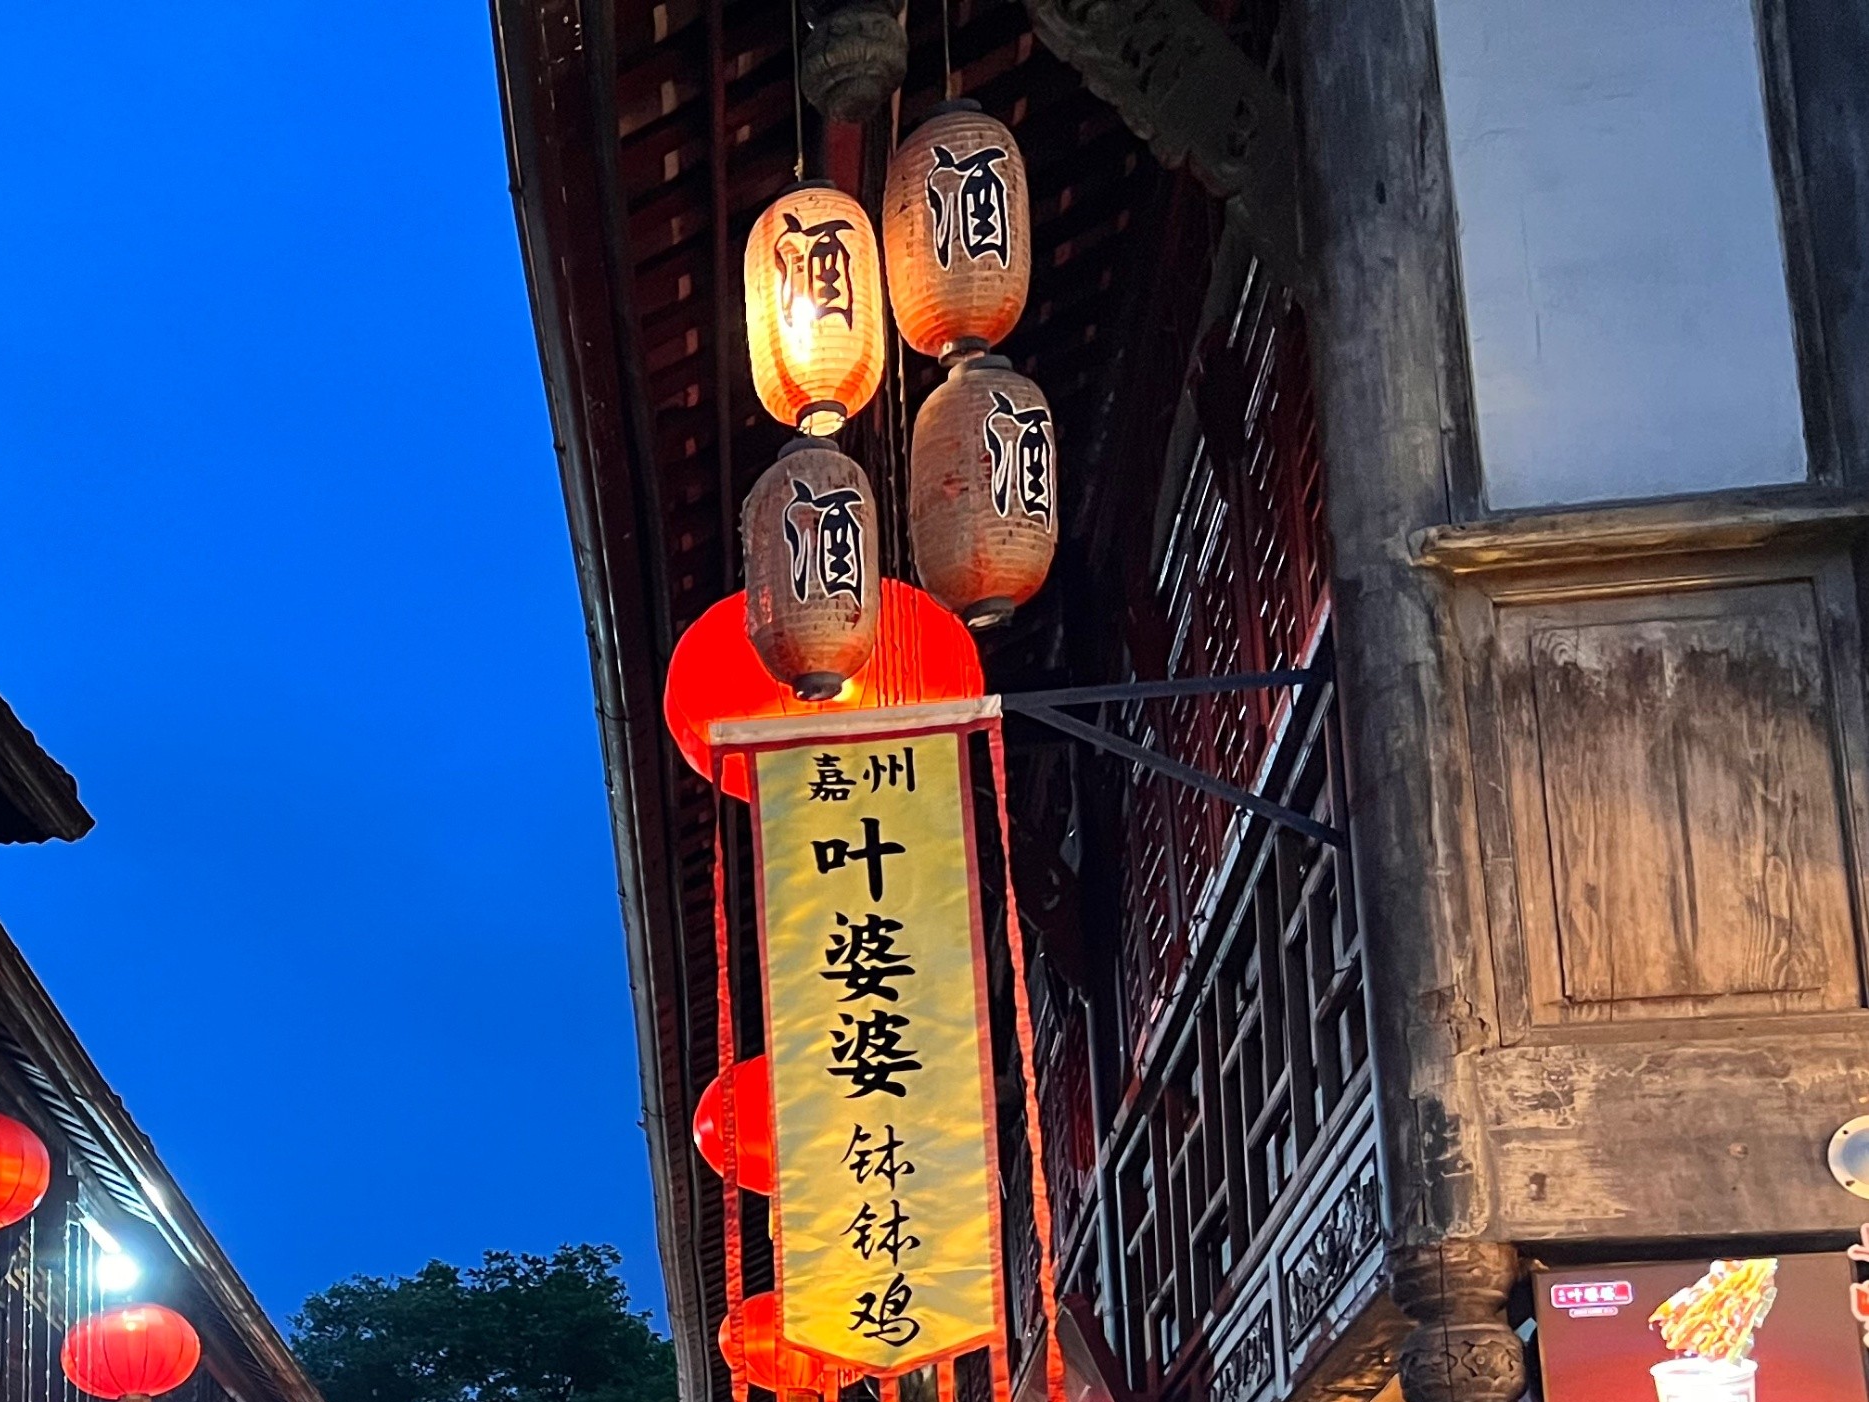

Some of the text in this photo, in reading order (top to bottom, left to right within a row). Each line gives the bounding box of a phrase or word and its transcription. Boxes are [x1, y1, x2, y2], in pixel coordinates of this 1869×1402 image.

[775, 212, 856, 330] 酒
[927, 146, 1009, 270] 酒
[984, 391, 1055, 533] 酒
[785, 479, 865, 608] 酒
[808, 746, 917, 802] 嘉州
[811, 817, 923, 1099] 叶婆婆
[840, 1122, 922, 1347] 钵钵鸡
